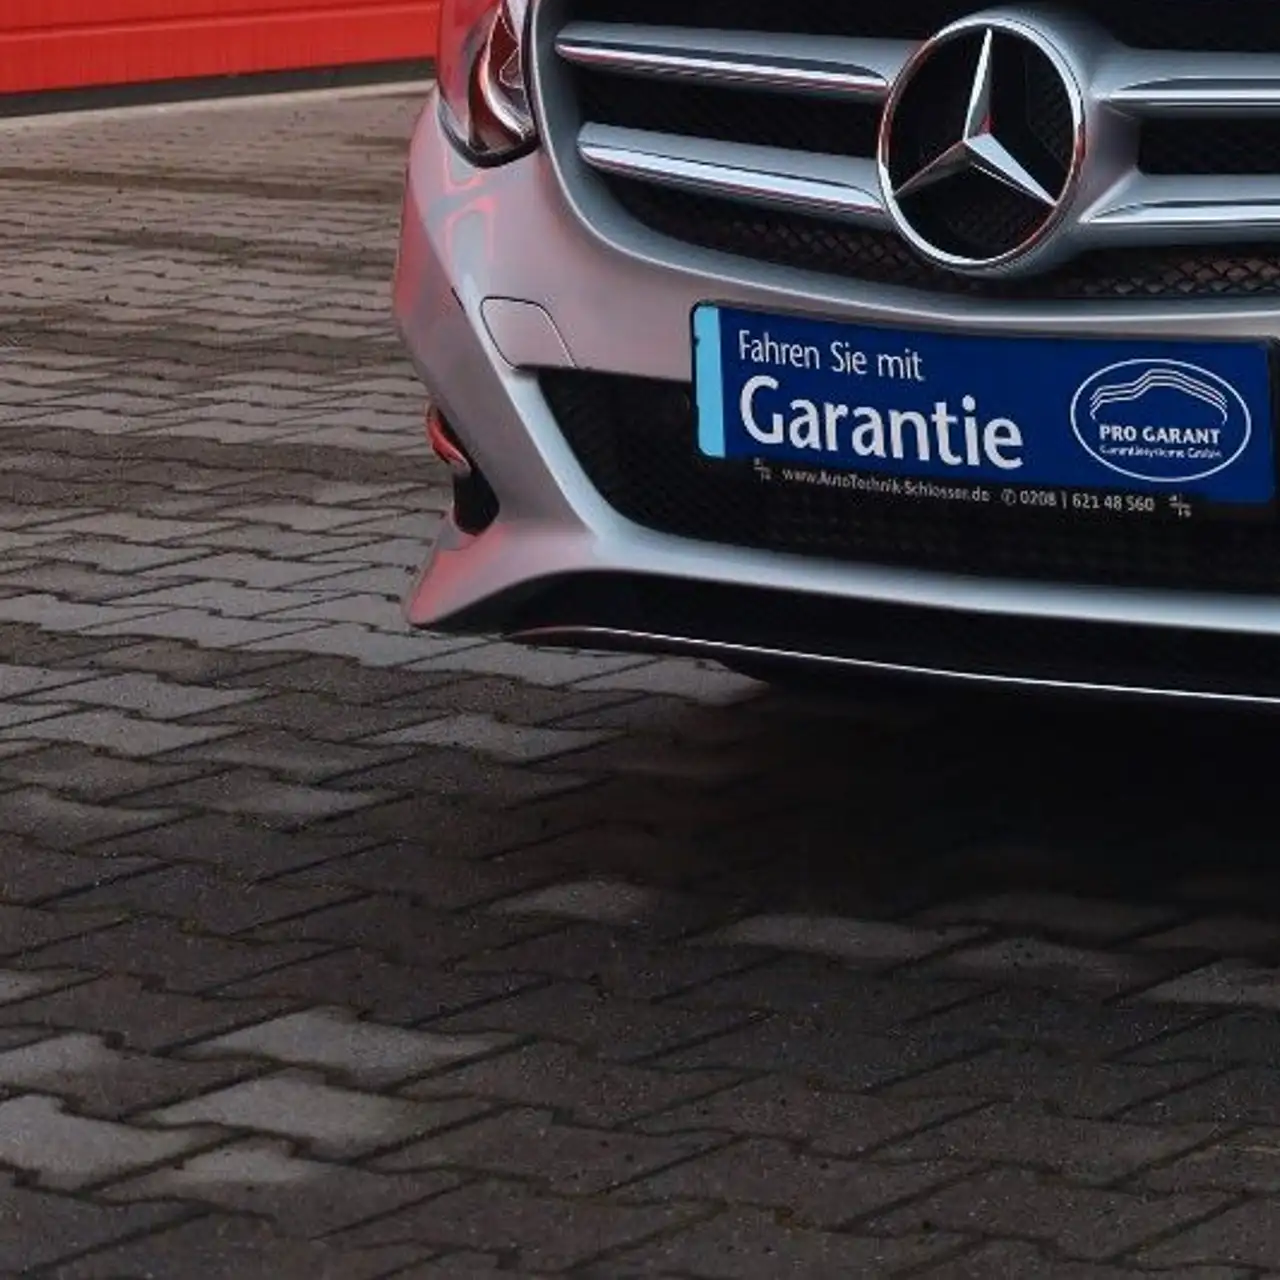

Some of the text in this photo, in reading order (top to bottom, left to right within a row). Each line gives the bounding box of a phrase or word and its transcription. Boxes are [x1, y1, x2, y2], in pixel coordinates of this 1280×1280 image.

[739, 329, 925, 382] Fahren Sie mit
[739, 375, 1024, 470] Garantie
[1100, 424, 1221, 445] PRO GARANT
[1020, 489, 1057, 506] 0208
[1072, 494, 1100, 509] 621
[1104, 494, 1122, 510] 48
[1126, 496, 1156, 512] 560
